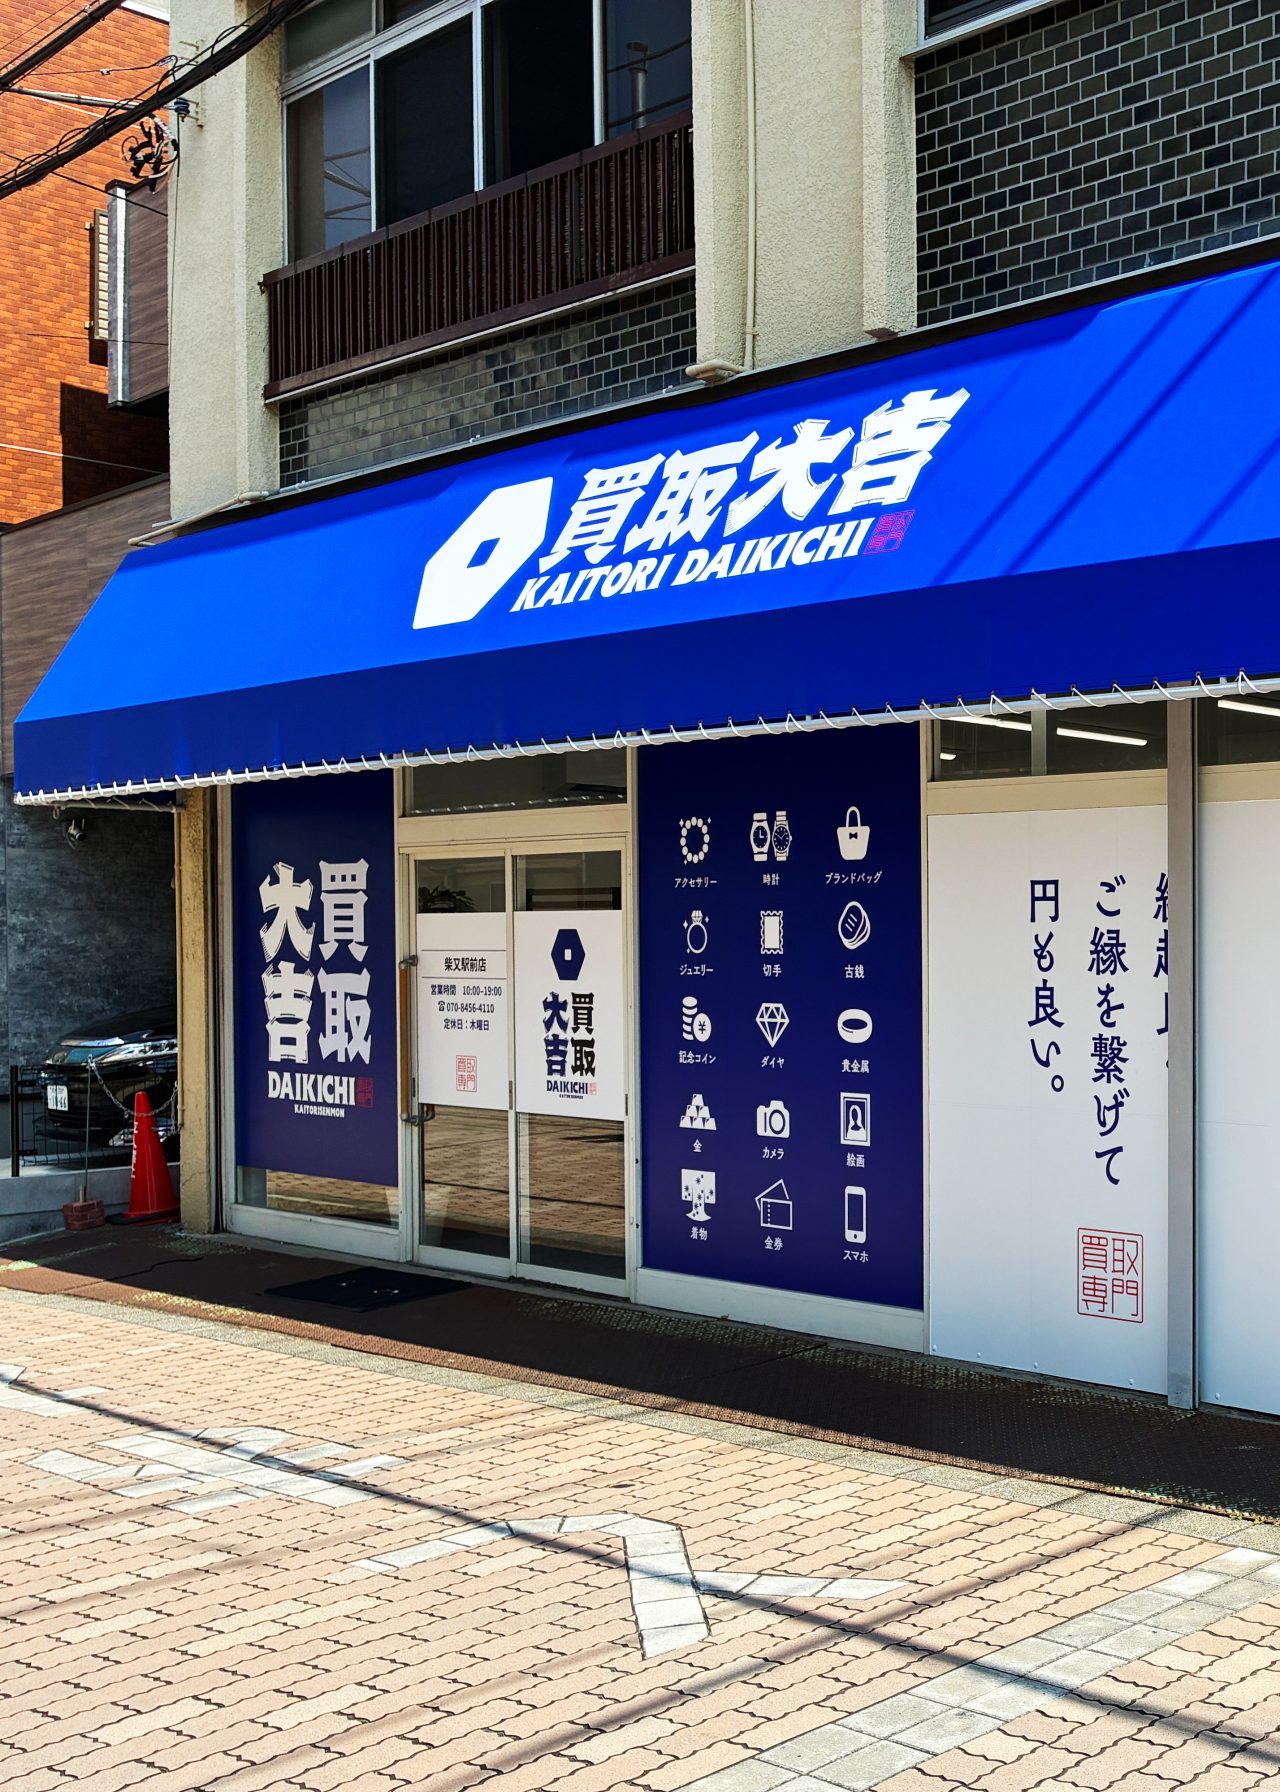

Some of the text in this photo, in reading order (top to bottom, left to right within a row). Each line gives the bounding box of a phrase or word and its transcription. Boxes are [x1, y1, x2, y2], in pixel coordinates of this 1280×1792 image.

[539, 387, 971, 570] 買取大吉
[509, 553, 676, 613] KAITORI
[671, 517, 876, 586] DAIKICHI
[674, 876, 718, 889] アクセサリー
[762, 873, 781, 886] 時計
[825, 870, 883, 885] ブランドバッグ
[258, 861, 316, 1065] 大吉
[317, 857, 372, 1065] 買取
[444, 956, 487, 973] 柴又駅前店
[679, 963, 714, 977] ジュエリー
[762, 963, 782, 978] 切手
[844, 964, 865, 980] 古銭
[430, 983, 503, 997] 営業時間 10:00-19:00
[1026, 878, 1065, 1093] 円も良い。
[446, 1002, 495, 1014] 070-8456-4110
[443, 1018, 490, 1031] 定休日：木曜日
[1086, 873, 1131, 1186] ご縁を繋げて
[542, 990, 569, 1077] 大吉
[571, 991, 596, 1077] 買取
[678, 1049, 717, 1065] 記念コイン
[760, 1055, 785, 1069] ダイヤ
[841, 1058, 870, 1074] 貴金属
[267, 1070, 356, 1107] DAIKICHI
[546, 1080, 588, 1095] DAIKICHI
[294, 1103, 345, 1119] KAITORISENMON
[692, 1138, 702, 1153] 金
[762, 1147, 785, 1160] カメラ
[845, 1152, 865, 1168] 絵画
[690, 1226, 708, 1241] 着物
[763, 1235, 783, 1251] 金券
[842, 1249, 869, 1263] スマホ
